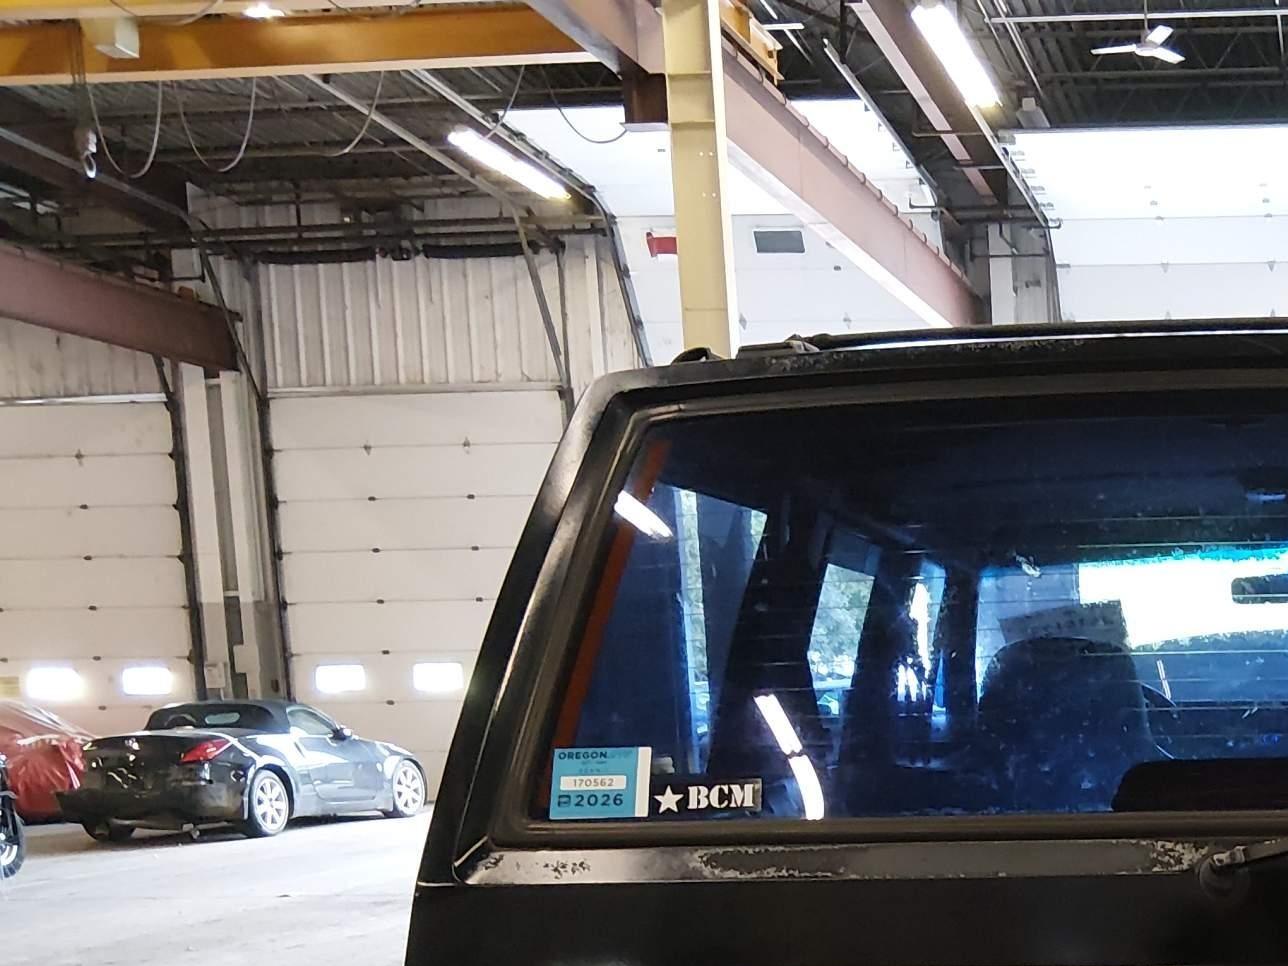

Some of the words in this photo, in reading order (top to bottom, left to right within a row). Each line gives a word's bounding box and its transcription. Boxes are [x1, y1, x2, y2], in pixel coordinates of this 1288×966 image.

[558, 751, 608, 760] OREGON
[573, 778, 614, 787] 170562
[574, 793, 623, 807] 2026
[687, 783, 755, 810] BCM
